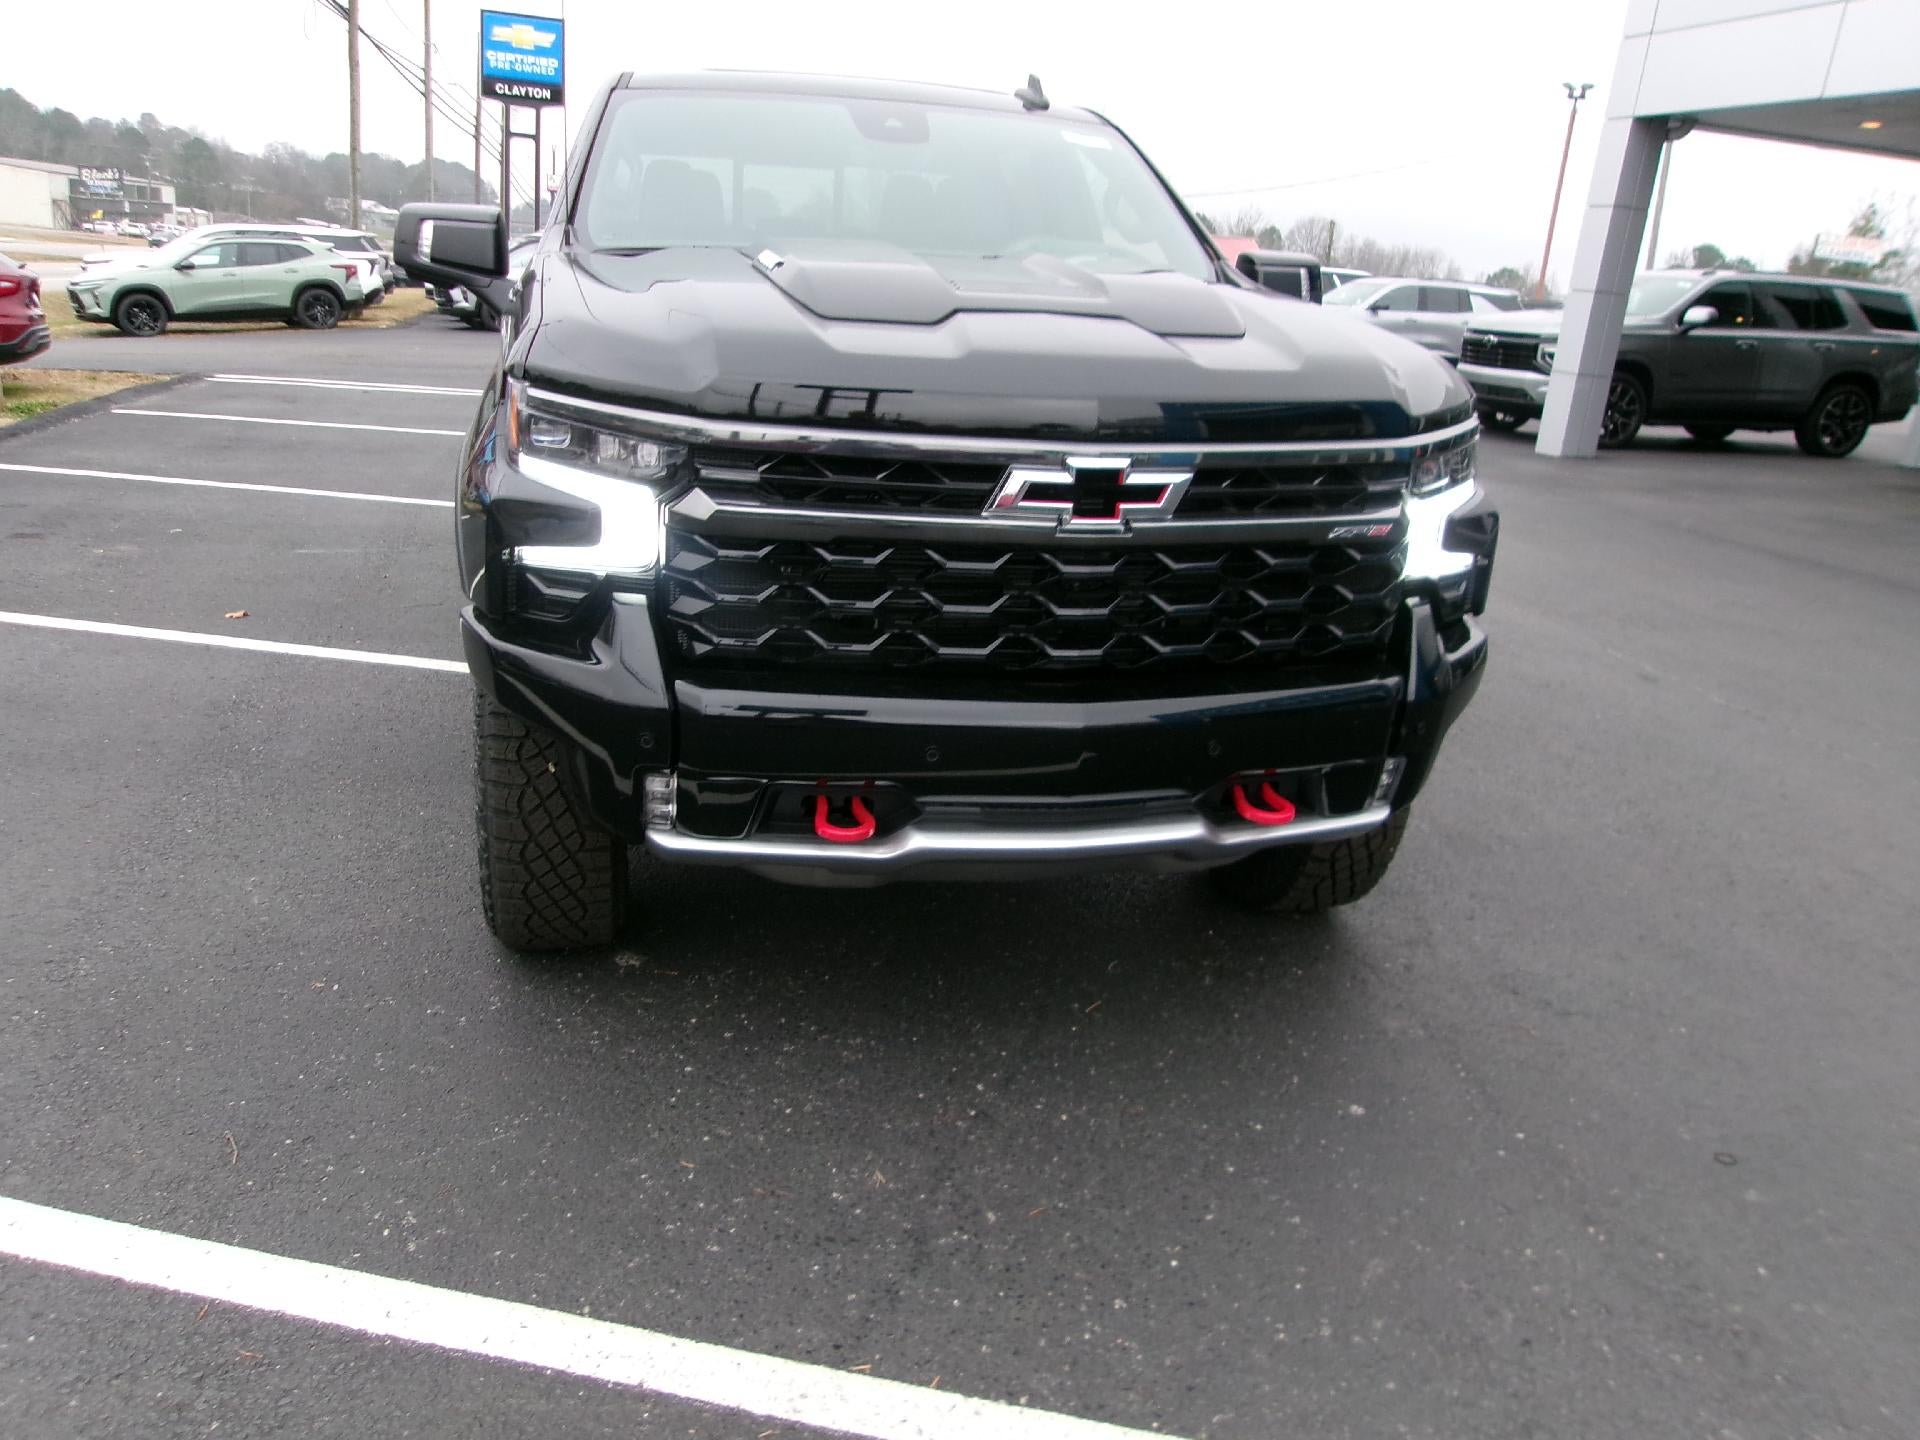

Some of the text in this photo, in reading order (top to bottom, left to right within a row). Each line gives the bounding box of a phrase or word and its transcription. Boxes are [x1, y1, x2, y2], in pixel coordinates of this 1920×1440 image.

[487, 50, 559, 68] CERTIFIED
[489, 60, 555, 76] PRE-OWNED
[495, 82, 551, 100] CLAYTON
